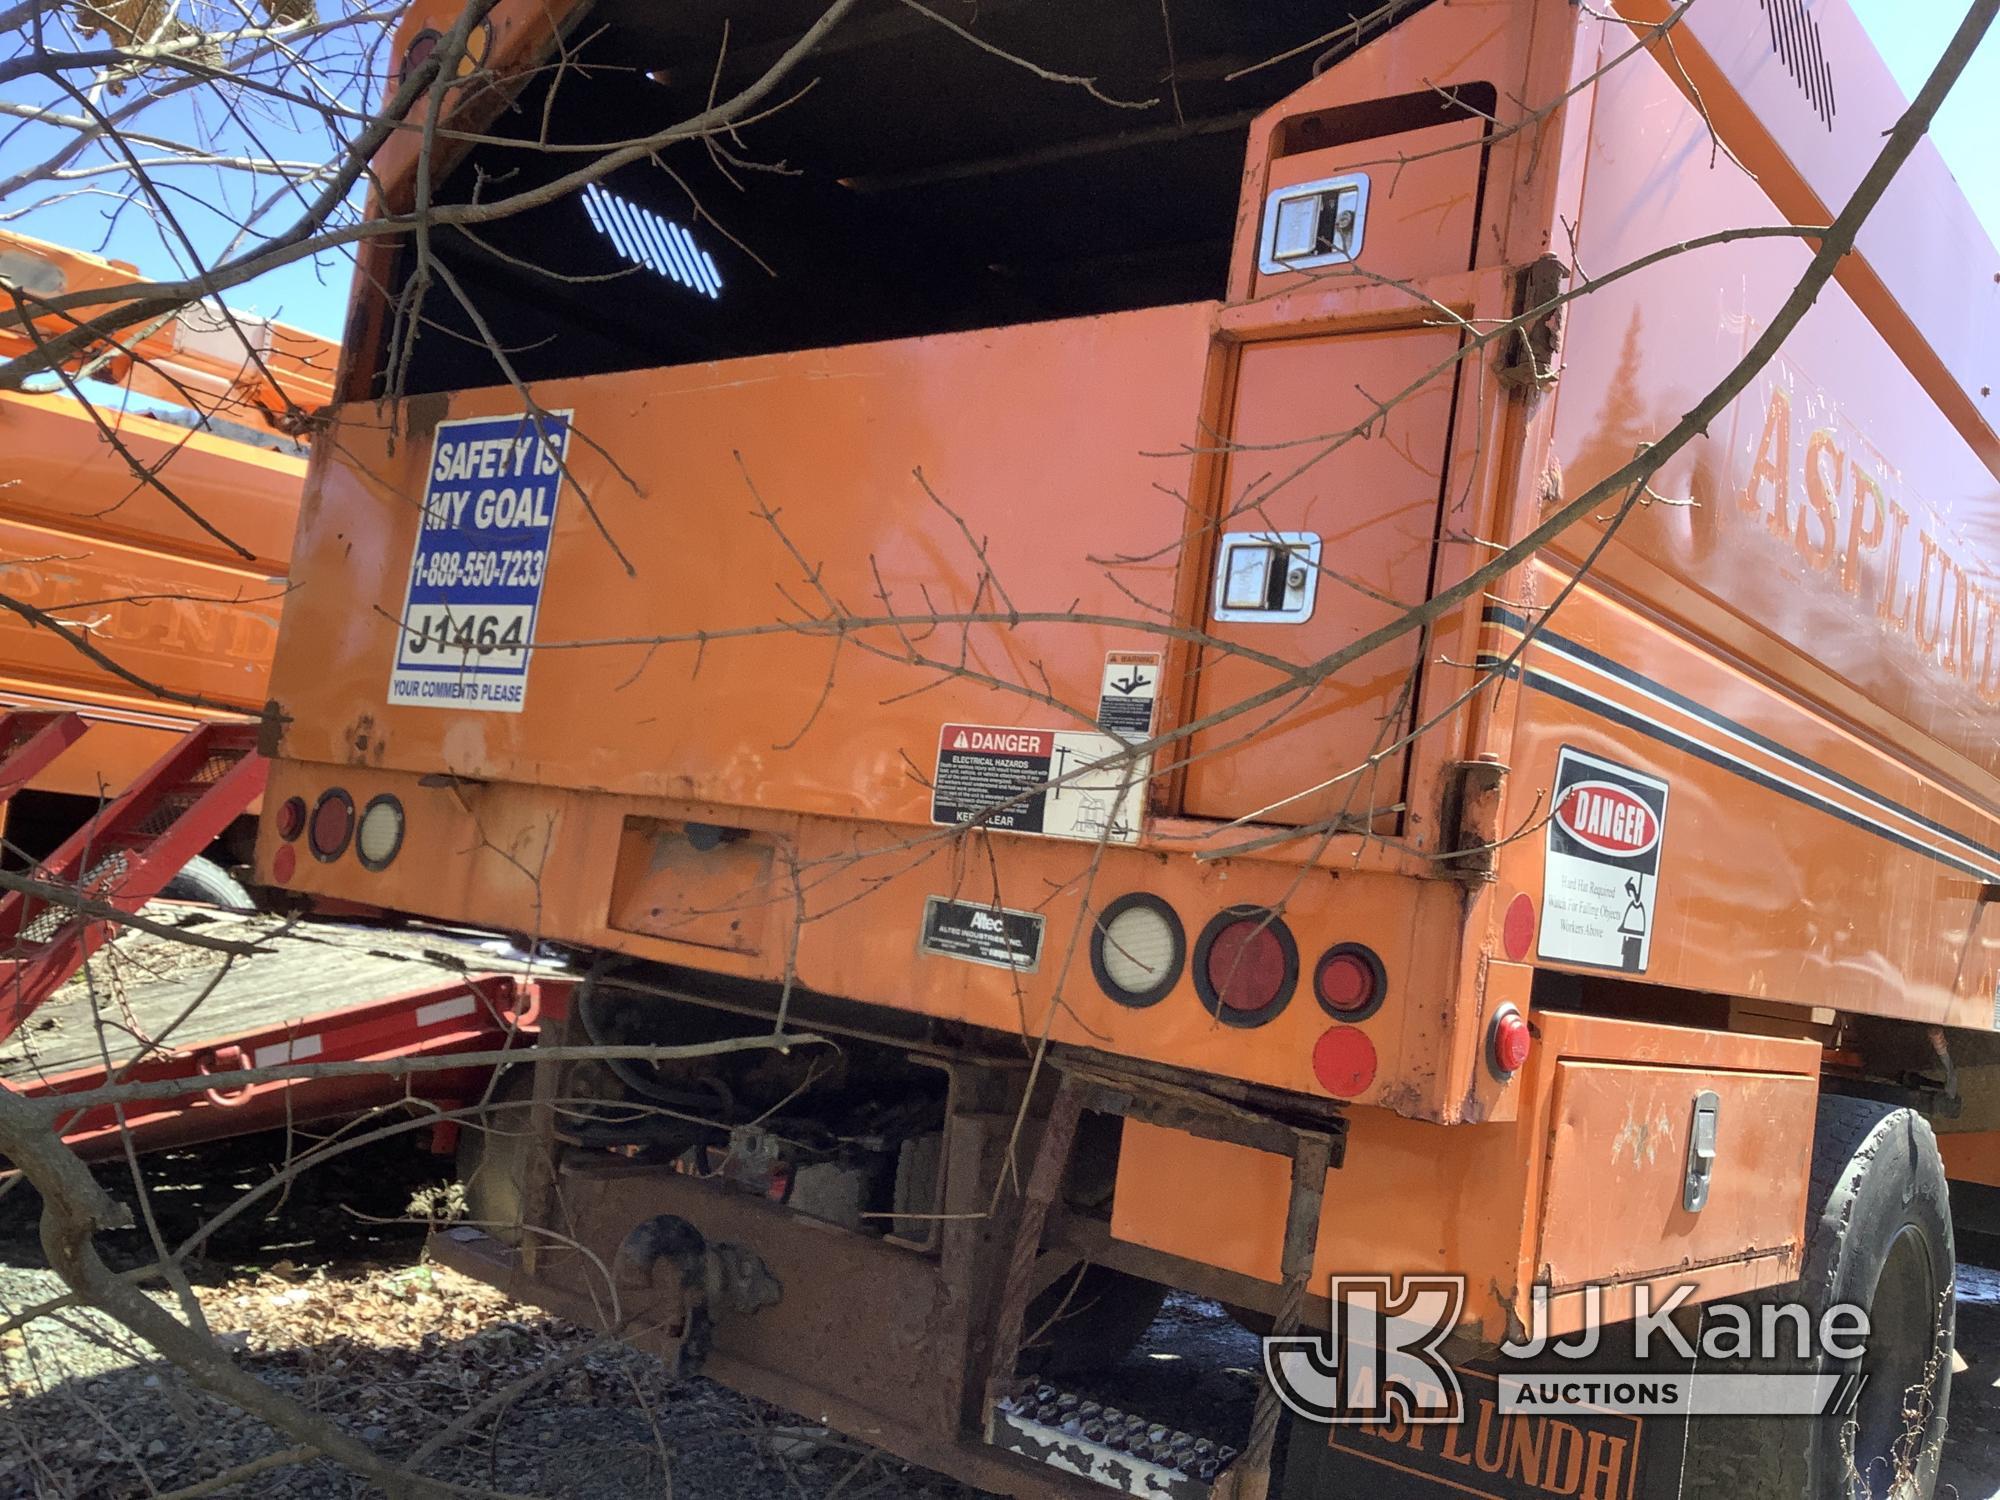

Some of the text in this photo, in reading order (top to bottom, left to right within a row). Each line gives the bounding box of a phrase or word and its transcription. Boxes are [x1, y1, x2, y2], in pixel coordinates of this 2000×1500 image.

[435, 434, 562, 482] SAFETY IS
[425, 487, 549, 531] MY GOAL
[414, 550, 543, 588] 1-888-550-7233
[409, 614, 524, 656] J1464
[393, 679, 522, 703] YOUR COMMENTS PLEASE
[971, 732, 1040, 752] DANGER
[952, 755, 1029, 769] ELECTRICAL HAZARDS
[1574, 791, 1644, 846] DANGER
[970, 911, 1003, 932] Altec
